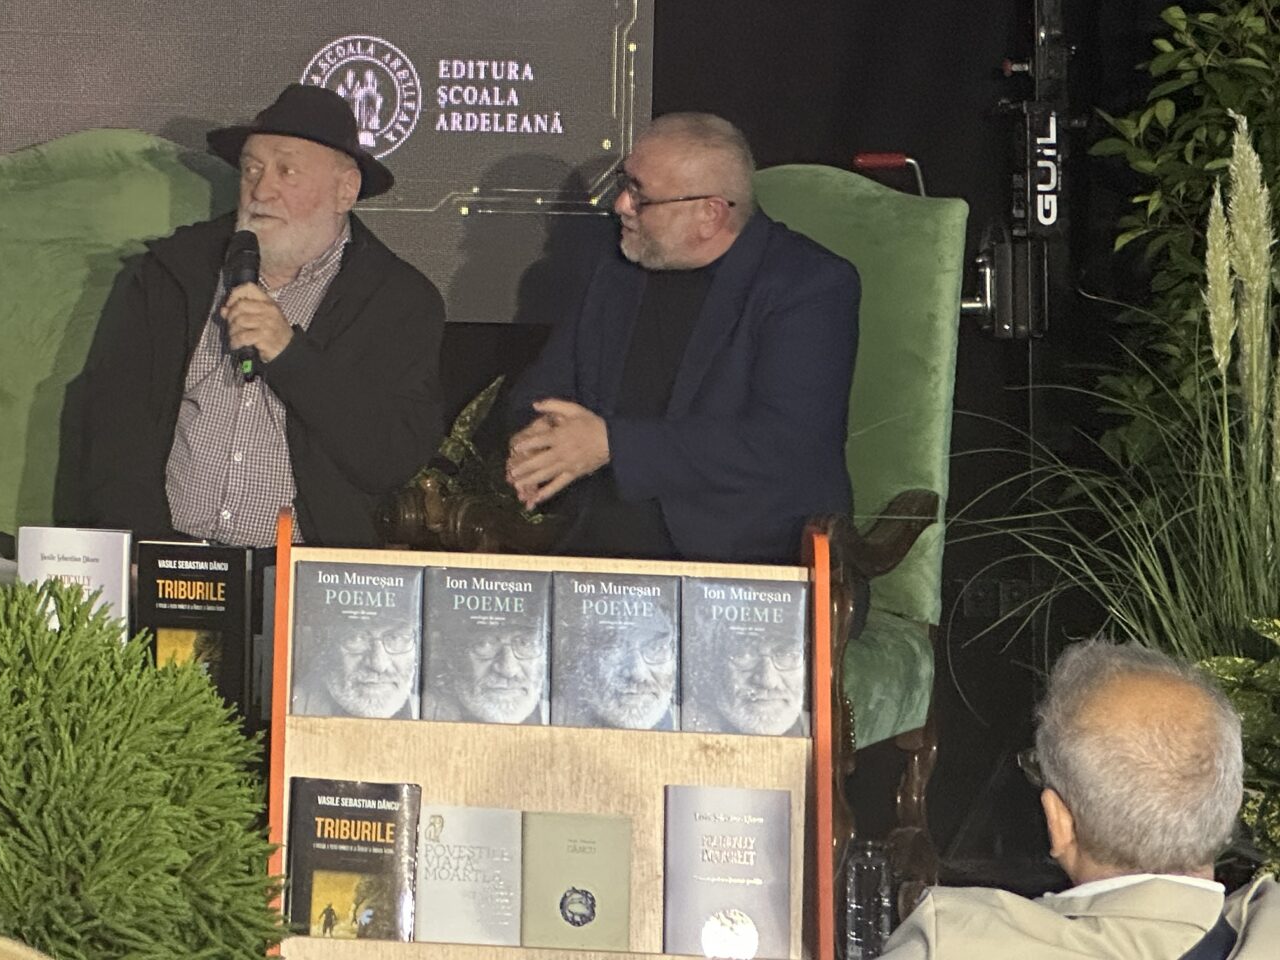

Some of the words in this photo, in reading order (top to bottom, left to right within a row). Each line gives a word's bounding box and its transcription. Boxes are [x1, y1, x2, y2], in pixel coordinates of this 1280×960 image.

[438, 59, 535, 82] EDITURA
[436, 85, 520, 109] ȘCOALA
[435, 111, 565, 134] ARDELEANĂ
[158, 559, 178, 569] VASILE
[178, 560, 209, 571] SEBASTIAN
[317, 570, 340, 584] Ion
[344, 572, 405, 588] Mureșan
[445, 575, 468, 590] Ion
[472, 577, 533, 594] Mureșan
[156, 579, 227, 602] TRIBURILE
[324, 589, 397, 608] POEME
[573, 580, 596, 594] Ion
[600, 581, 662, 598] Mureșan
[703, 586, 726, 600] Ion
[730, 587, 792, 604] Mureșan
[452, 594, 525, 614] POEME
[581, 599, 655, 618] POEME
[710, 605, 785, 624] POEME
[317, 795, 340, 807] VASILE
[340, 797, 377, 809] SEBASTIAN
[314, 816, 397, 844] TRIBURILE
